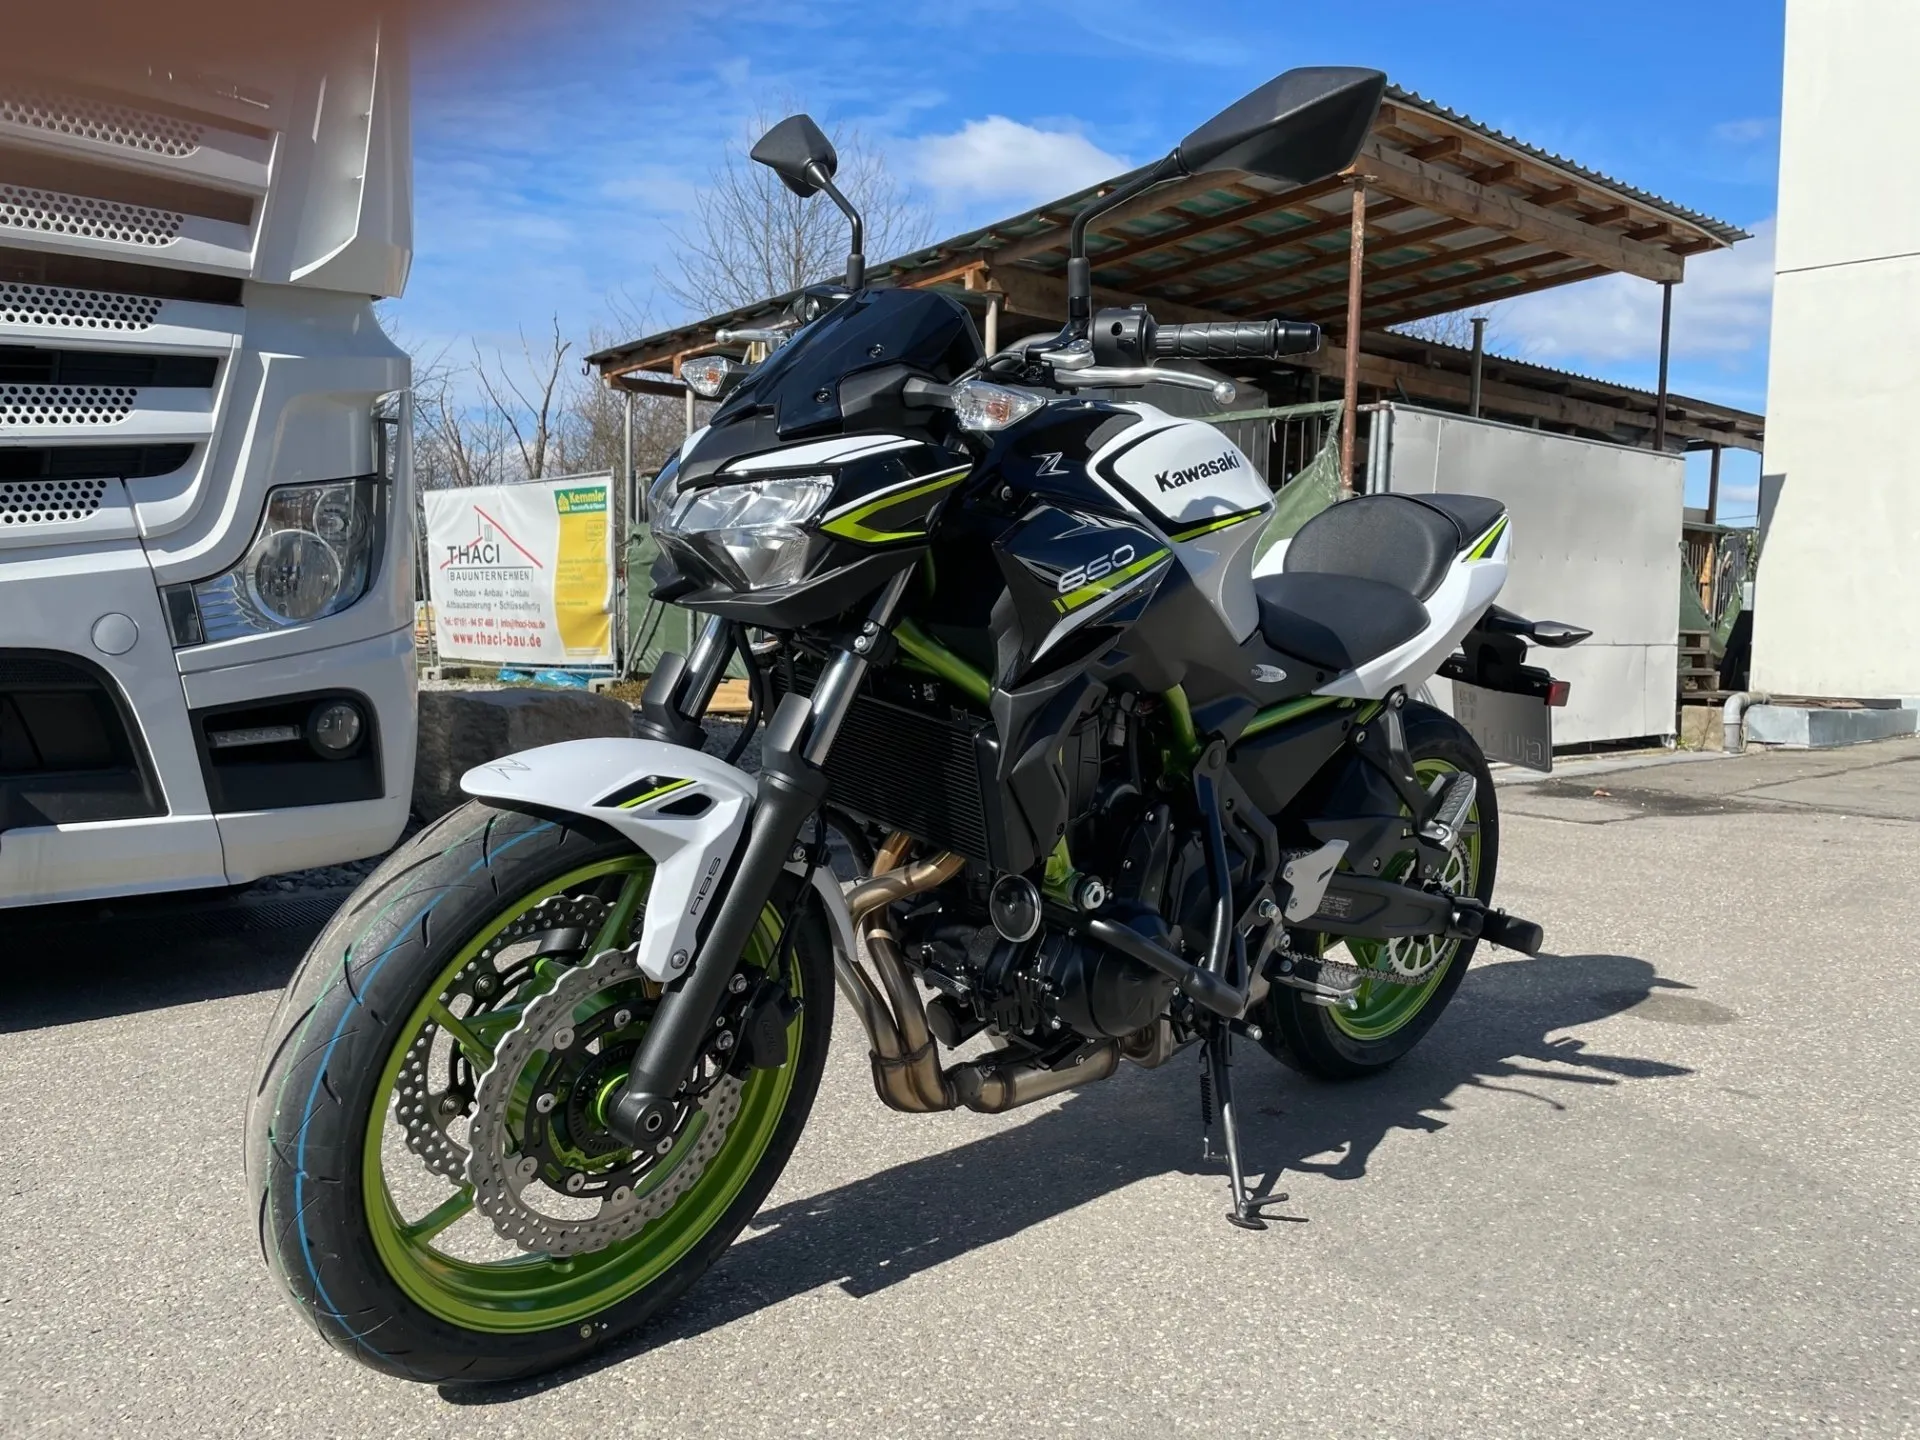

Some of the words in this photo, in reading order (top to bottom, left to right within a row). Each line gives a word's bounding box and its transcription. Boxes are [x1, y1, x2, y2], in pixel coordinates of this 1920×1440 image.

[1154, 450, 1241, 493] Kawasaki
[569, 489, 606, 504] Kemmler
[447, 543, 500, 565] THACI
[449, 570, 530, 581] BAUUNTERNEHMEN
[1057, 544, 1135, 593] 650
[453, 588, 476, 598] Rohbau
[484, 588, 503, 598] Anbau
[510, 588, 530, 598] Umbau
[446, 600, 492, 611] Altbausanierung
[453, 631, 542, 648] www.thaci-bau.de
[690, 856, 721, 916] ABS
